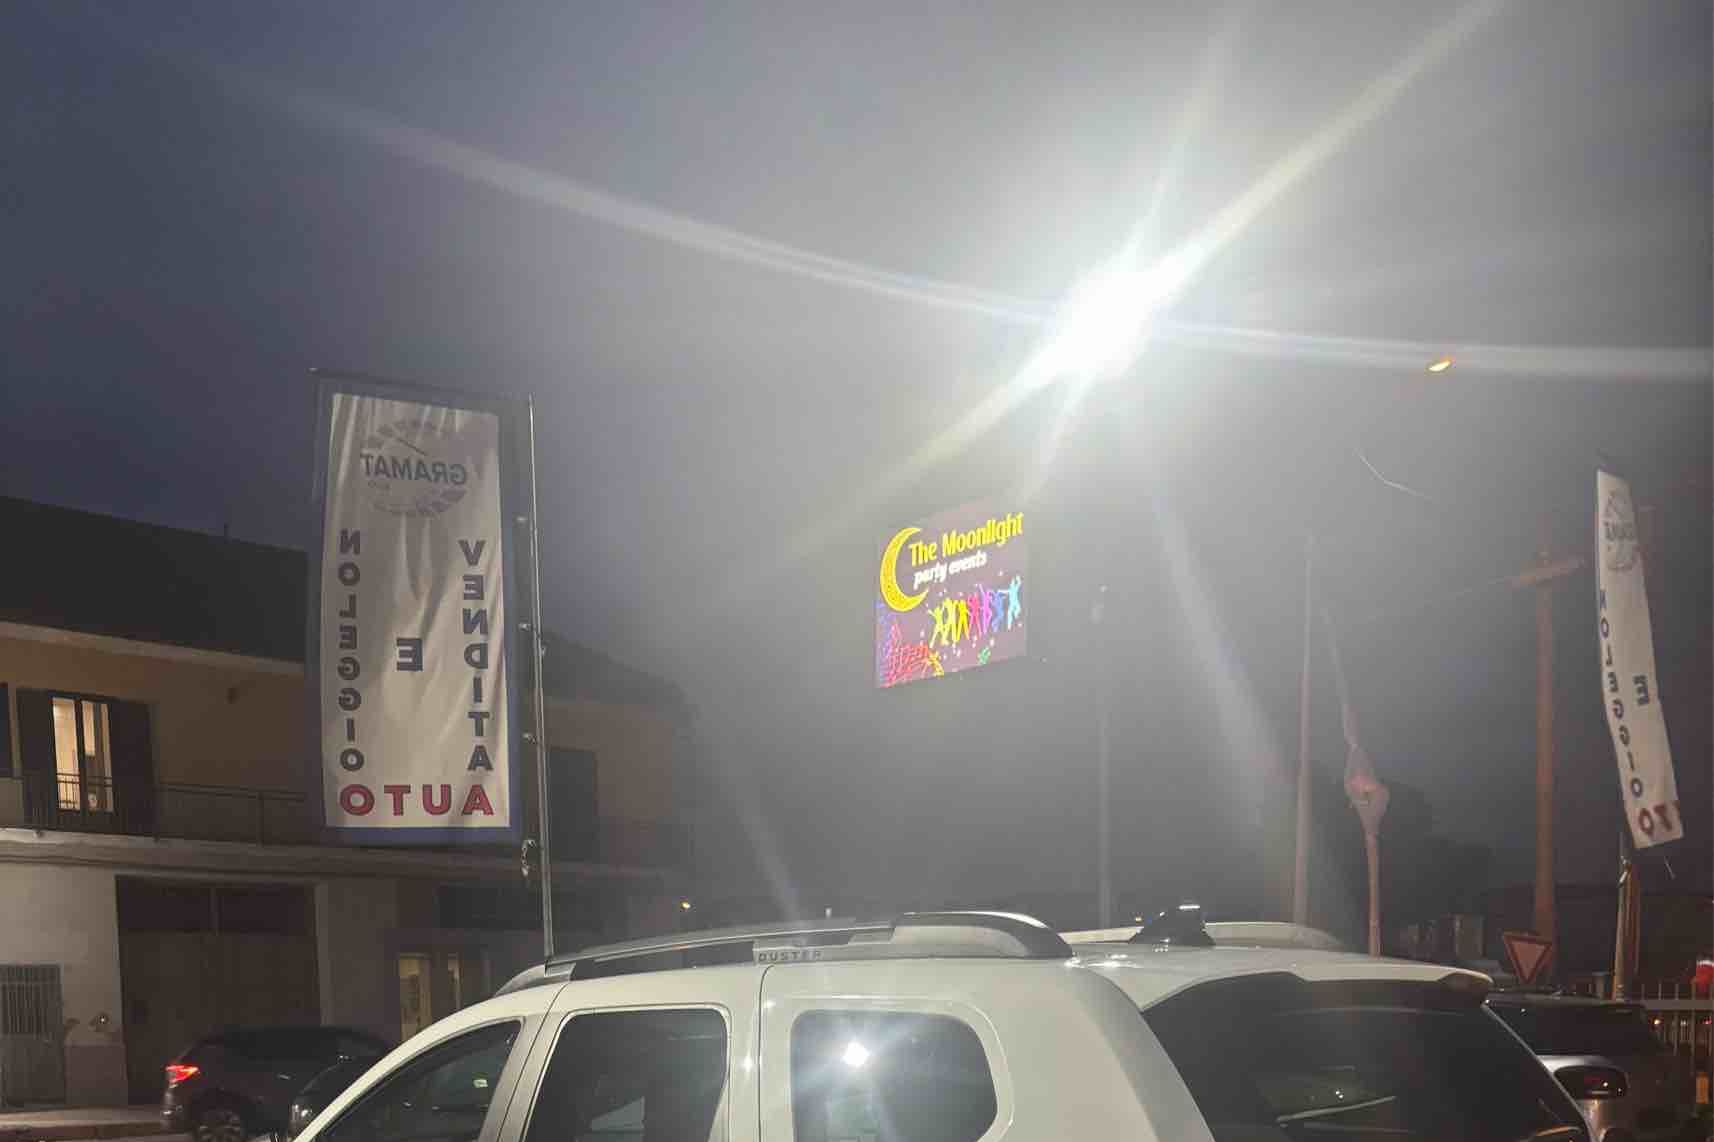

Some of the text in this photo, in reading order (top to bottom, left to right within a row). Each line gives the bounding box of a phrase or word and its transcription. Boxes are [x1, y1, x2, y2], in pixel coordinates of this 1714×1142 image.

[909, 511, 1025, 567] The Moonlight
[913, 550, 988, 590] party events
[758, 950, 824, 962] DUSTER
